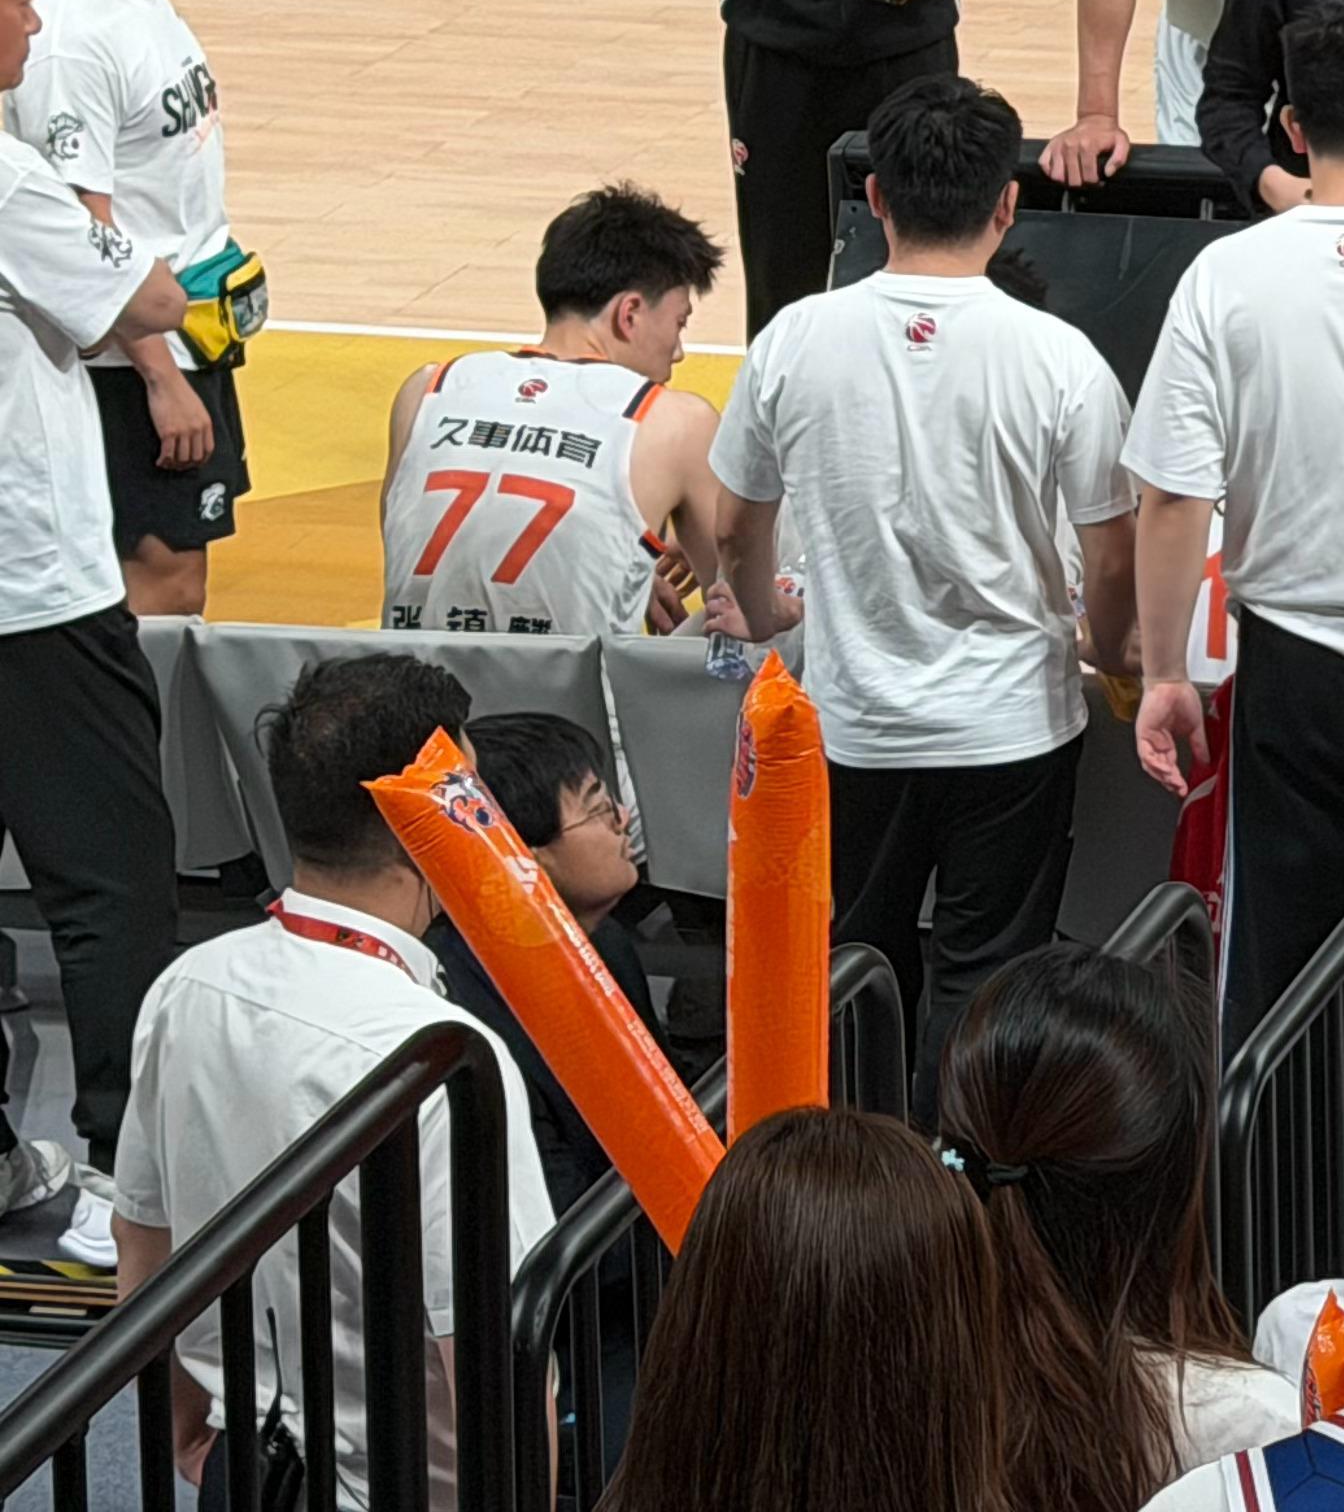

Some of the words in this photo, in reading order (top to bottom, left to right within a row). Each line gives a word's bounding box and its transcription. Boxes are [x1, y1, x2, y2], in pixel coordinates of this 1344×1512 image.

[430, 416, 603, 469] 久事体育
[414, 470, 576, 585] 77
